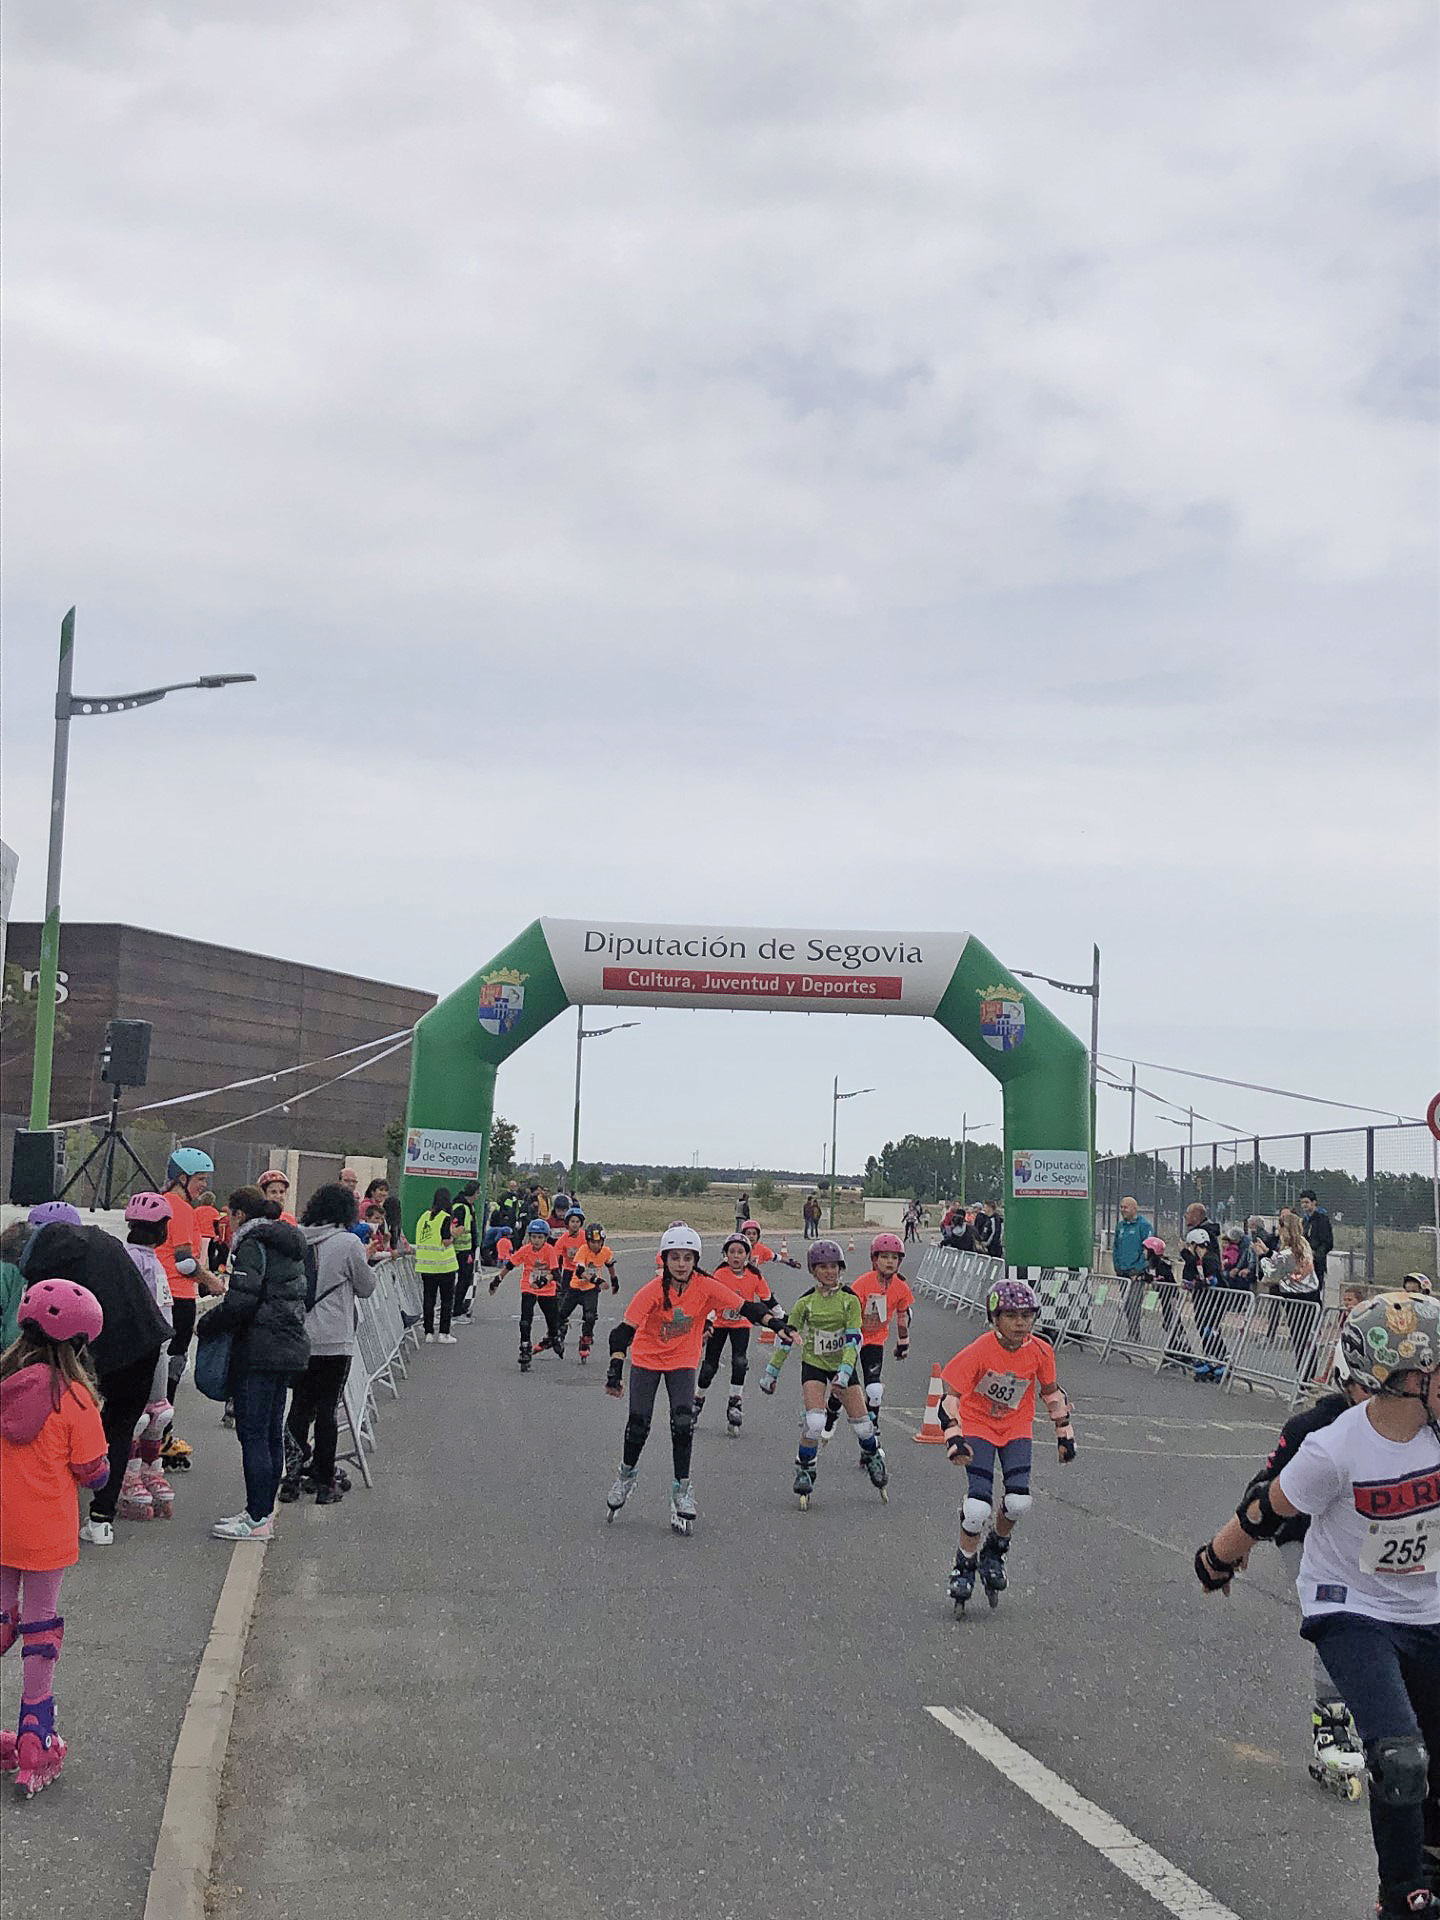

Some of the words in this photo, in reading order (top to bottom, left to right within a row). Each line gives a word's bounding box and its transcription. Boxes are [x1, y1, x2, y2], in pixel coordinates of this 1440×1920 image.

[584, 931, 746, 961] Diputación
[758, 938, 796, 960] de
[807, 939, 924, 970] Segovia
[628, 970, 697, 989] Cultura,
[701, 974, 780, 991] Juventud
[785, 980, 796, 994] y
[802, 977, 877, 996] Deportes
[423, 1138, 478, 1152] Diputación
[422, 1151, 436, 1162] de
[438, 1152, 477, 1166] Segovia
[1034, 1159, 1087, 1171] Diputación
[1033, 1172, 1048, 1182] de
[1051, 1172, 1086, 1185] Segovia
[819, 1337, 844, 1351] 1490
[988, 1383, 1015, 1401] 983
[1379, 1535, 1427, 1564] 255
